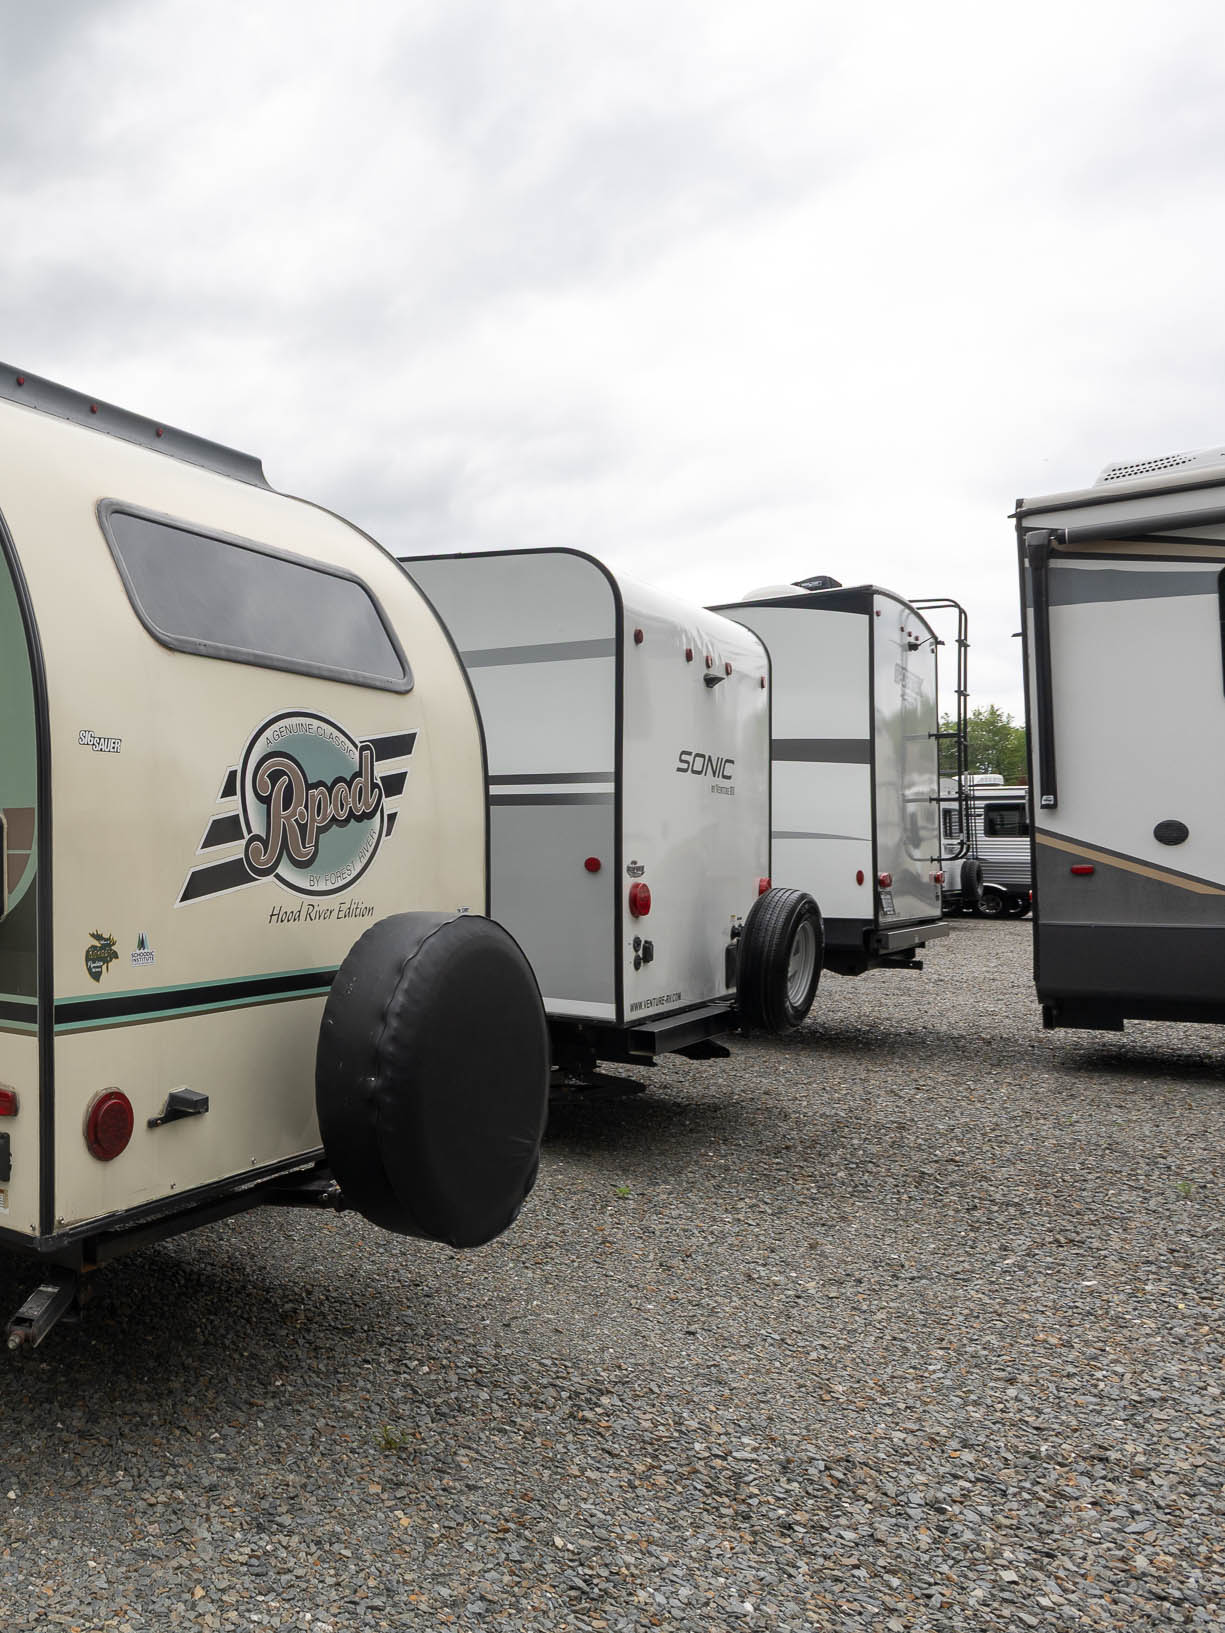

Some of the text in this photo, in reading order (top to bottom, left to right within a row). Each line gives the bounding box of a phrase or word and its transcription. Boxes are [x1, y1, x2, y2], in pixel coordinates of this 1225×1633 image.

[79, 730, 95, 745] SIG
[92, 737, 121, 753] SAUER
[265, 723, 357, 760] A GENUINE CLASSIC
[676, 750, 735, 780] SONIC
[309, 828, 376, 887] BY FOREST RIVER
[268, 899, 374, 924] Hood River Edition
